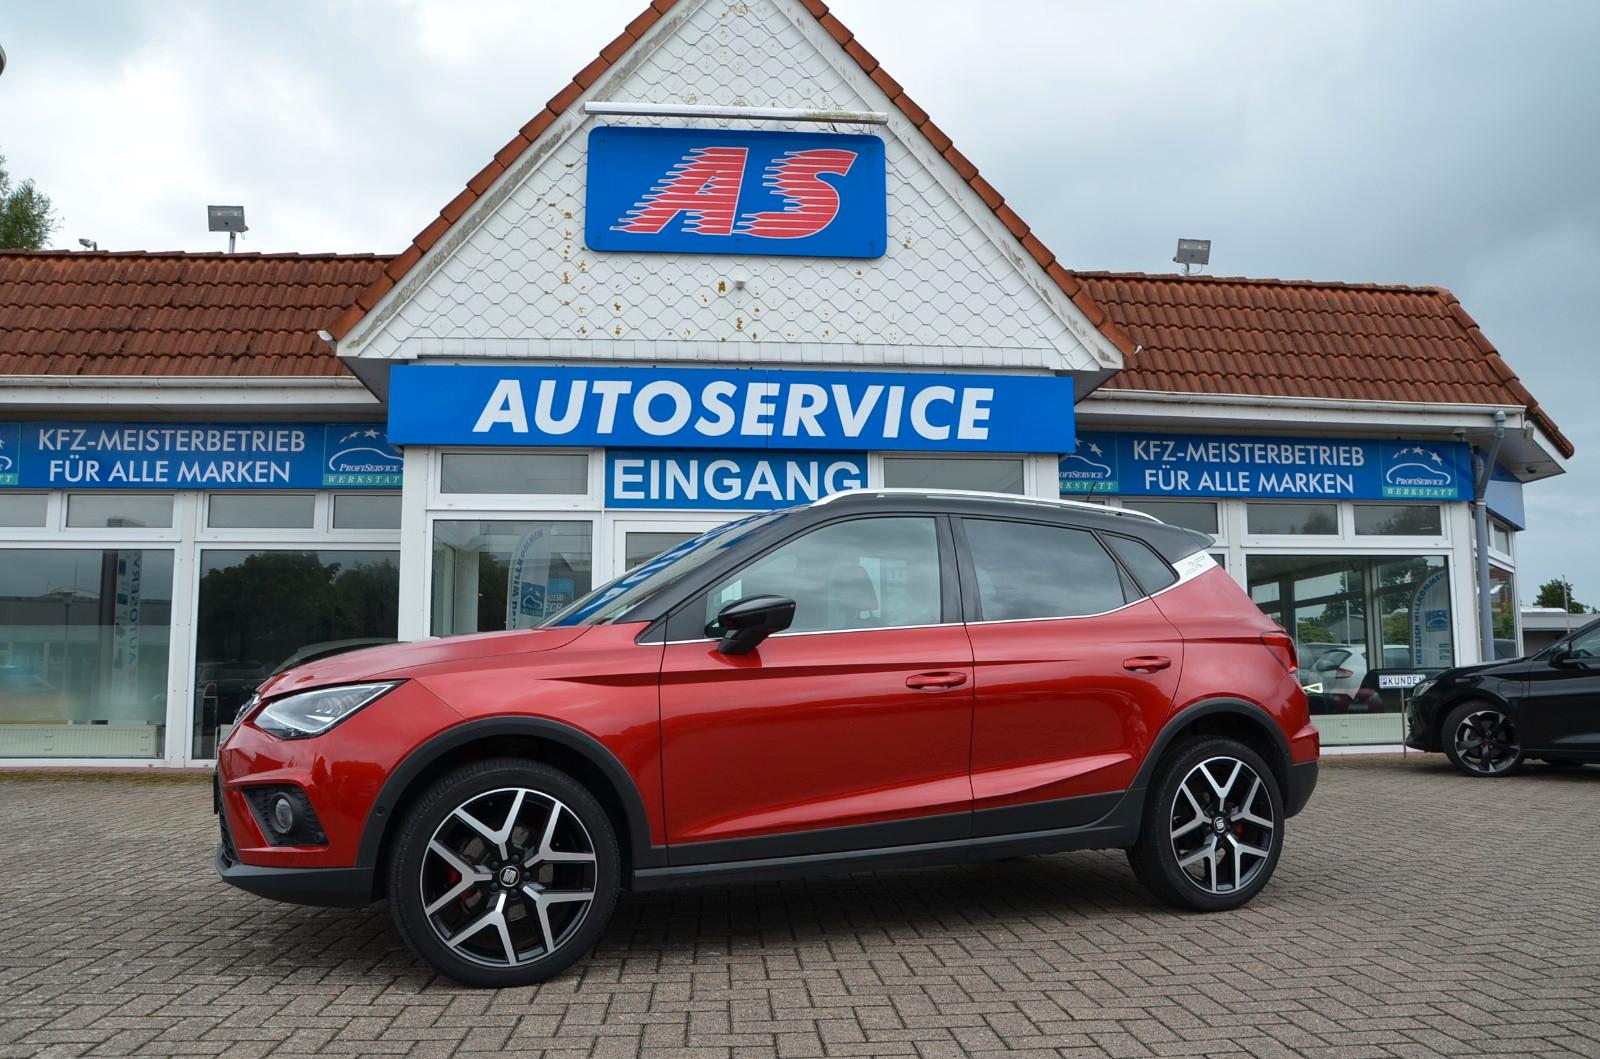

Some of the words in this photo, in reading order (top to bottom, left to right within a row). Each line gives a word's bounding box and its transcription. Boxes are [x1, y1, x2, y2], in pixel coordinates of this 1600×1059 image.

[609, 146, 858, 239] AS
[472, 379, 995, 441] AUTOSERVICE
[38, 428, 306, 452] KFZ-MEISTERBETRIEB
[1133, 440, 1364, 467] KFZ-MEISTERBETRIEB
[49, 454, 101, 482] FÜR
[107, 460, 169, 482] ALLE
[176, 461, 291, 483] MARKEN
[328, 475, 401, 484] WERKSTAT
[612, 458, 862, 502] EINGANG
[1144, 465, 1192, 491] FÜR
[1197, 471, 1250, 492] ALLE
[1257, 472, 1354, 494] MARKEN
[1387, 487, 1454, 497] WERKSTATT
